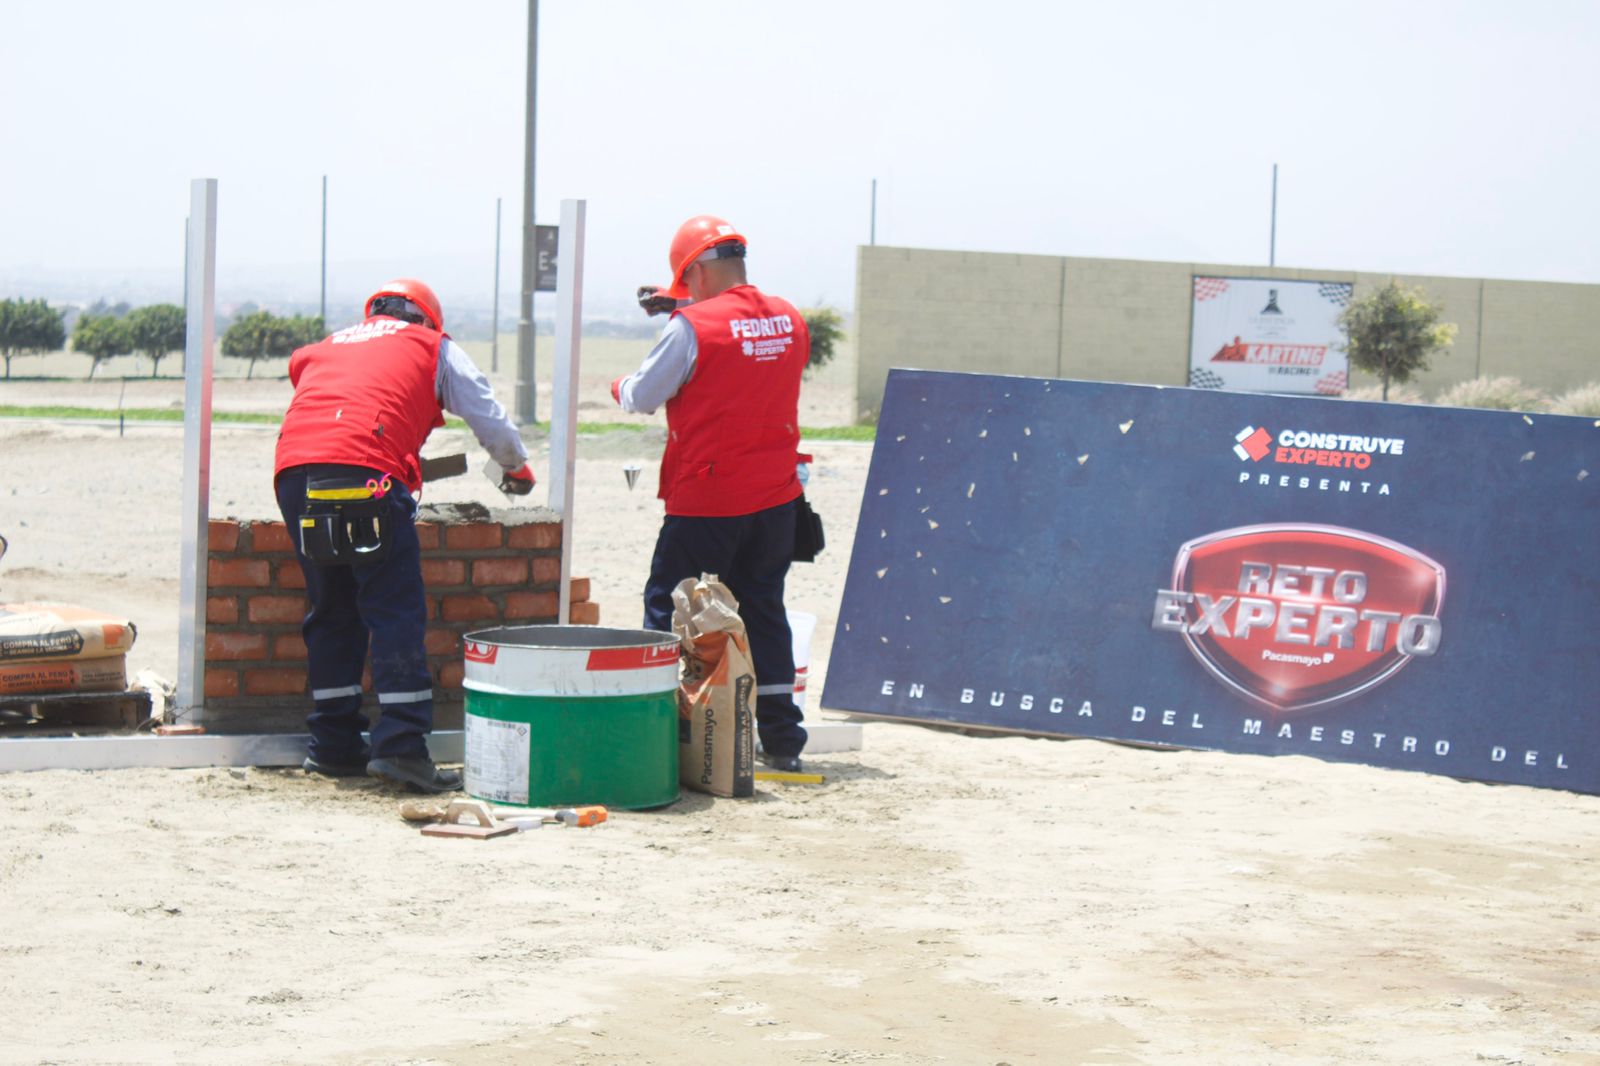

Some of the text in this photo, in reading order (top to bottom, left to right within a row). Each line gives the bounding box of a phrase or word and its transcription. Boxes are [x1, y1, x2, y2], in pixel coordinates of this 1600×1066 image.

[729, 314, 793, 338] PEDRITO
[1277, 366, 1313, 376] RACING
[1278, 430, 1405, 455] CONSTRUYE
[1275, 447, 1372, 470] EXPERTO
[1239, 472, 1390, 495] PRESENTA
[1237, 560, 1368, 604] RETO
[1152, 589, 1442, 656] EXPERTO
[1262, 649, 1322, 667] Pacasmayo
[881, 680, 1568, 769] EN BUSCA DEL MAESTRO DEL
[701, 708, 717, 785] Pacasmayo
